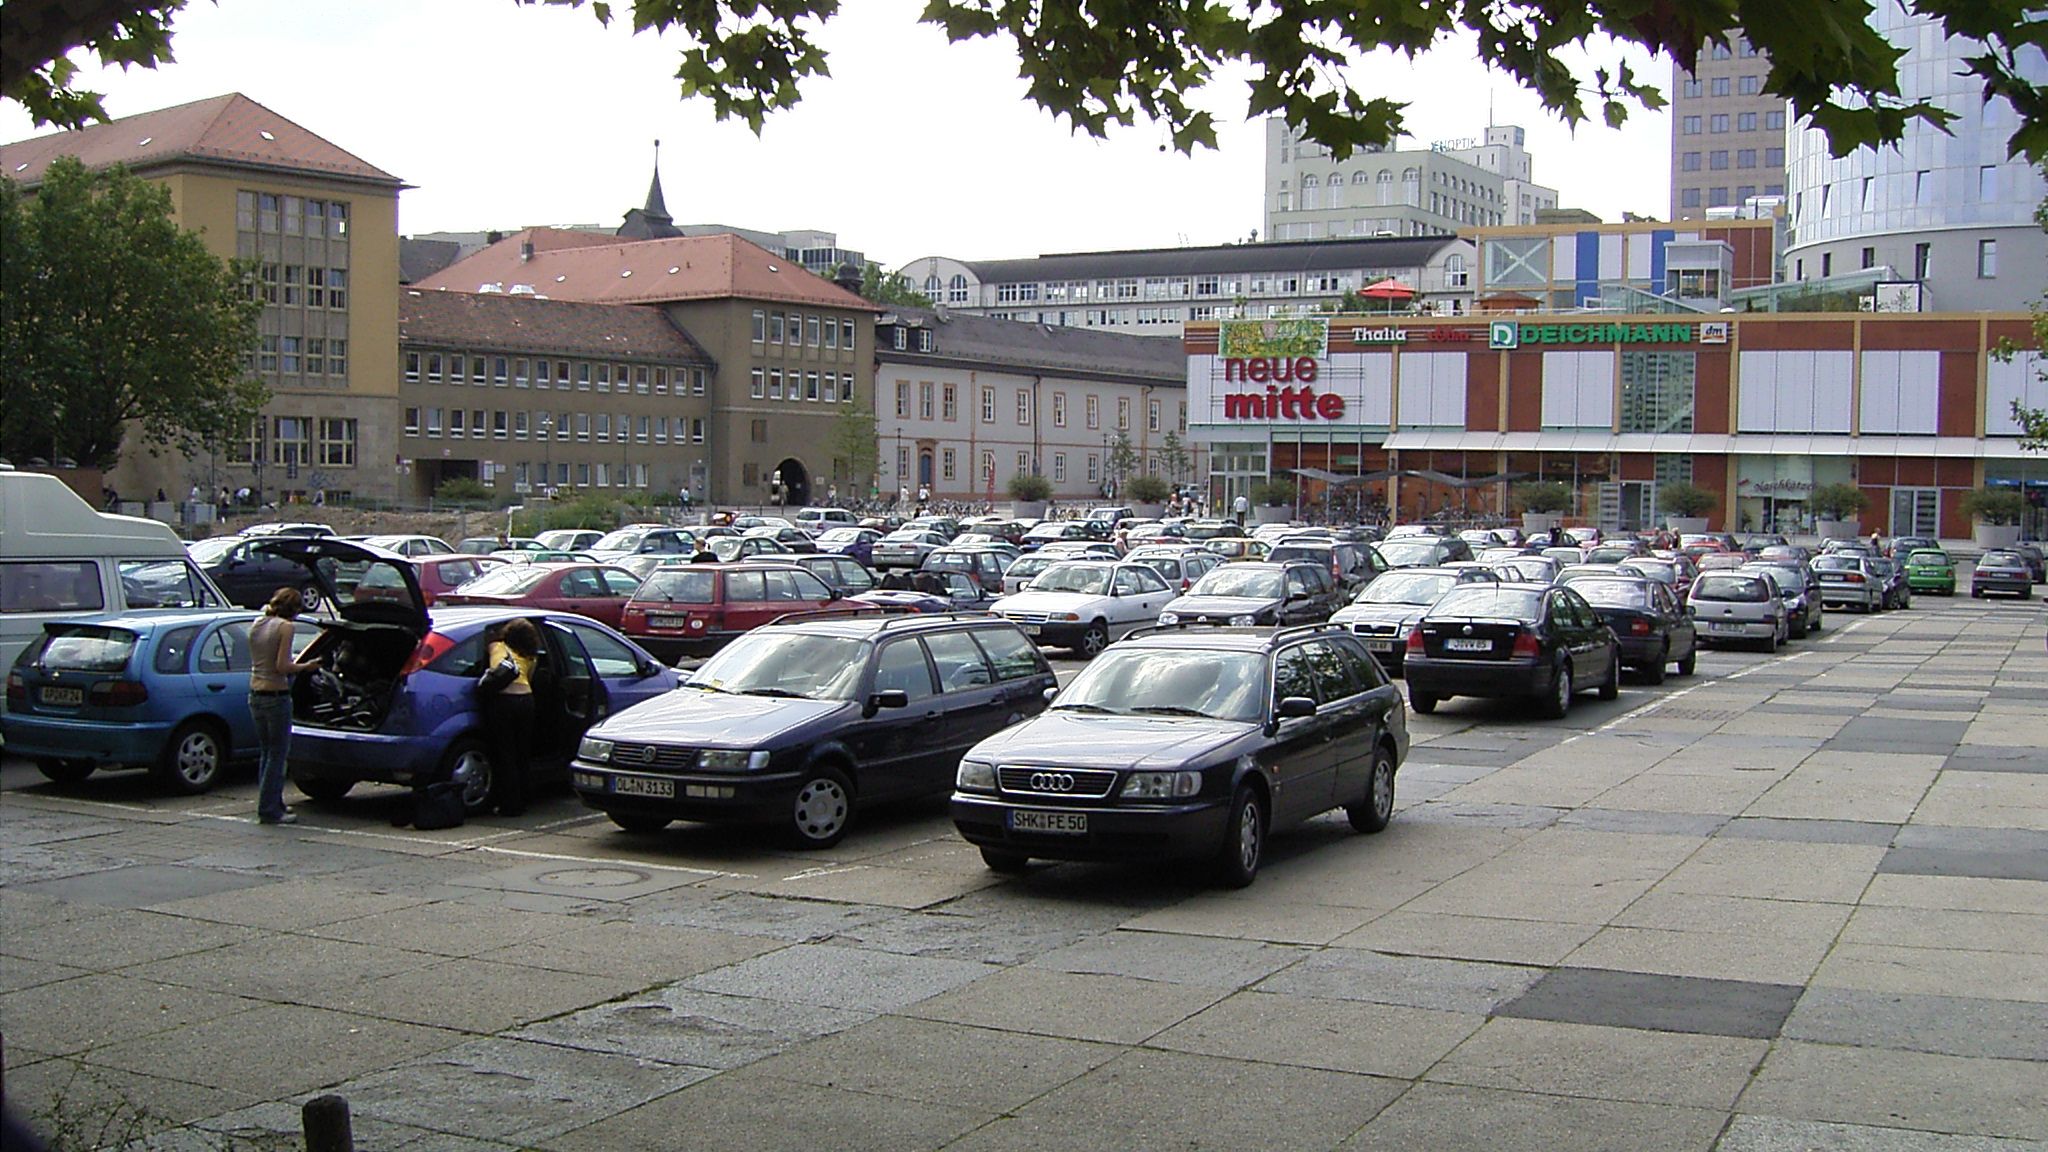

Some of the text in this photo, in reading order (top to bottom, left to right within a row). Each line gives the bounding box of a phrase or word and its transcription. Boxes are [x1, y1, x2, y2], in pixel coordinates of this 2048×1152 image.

[1352, 327, 1407, 341] Thalia
[1521, 324, 1691, 343] DEICHMANN
[1705, 325, 1723, 335] dm
[1225, 356, 1318, 382] neue
[1225, 385, 1345, 419] mitte
[646, 781, 673, 795] 3133
[1014, 812, 1086, 830] SHK FE 50
